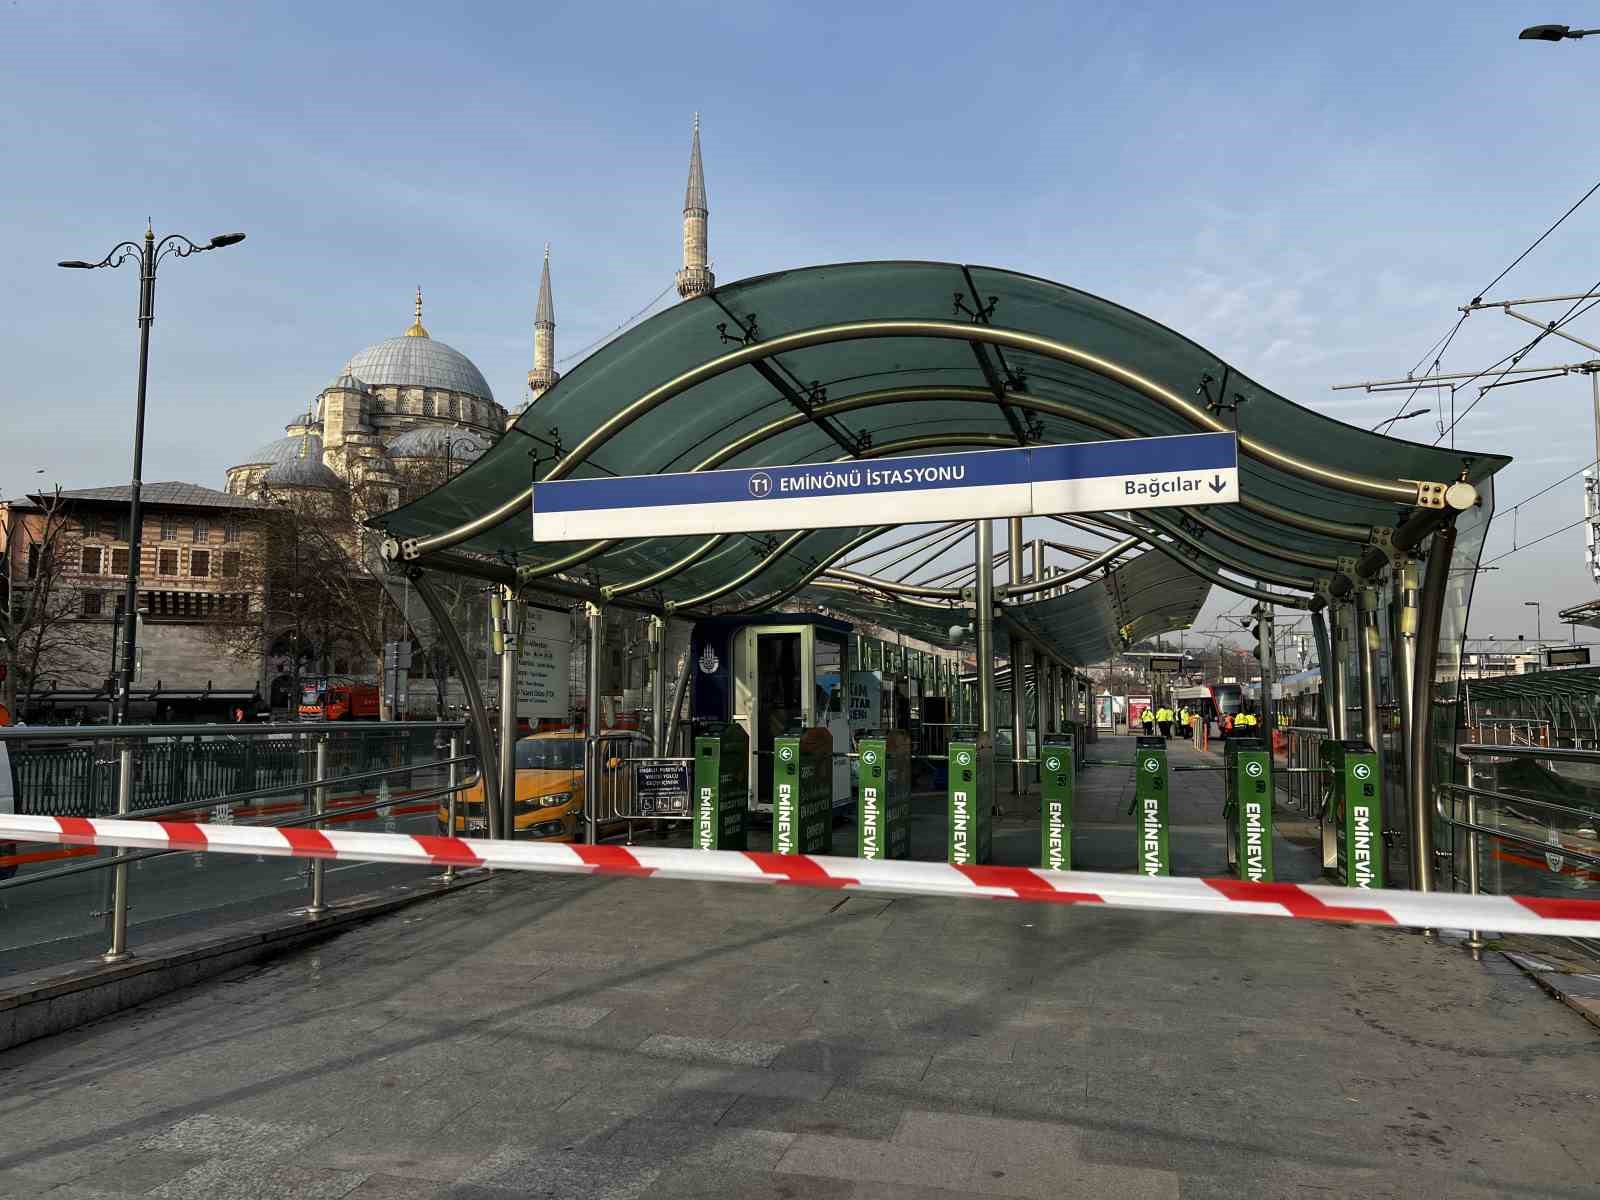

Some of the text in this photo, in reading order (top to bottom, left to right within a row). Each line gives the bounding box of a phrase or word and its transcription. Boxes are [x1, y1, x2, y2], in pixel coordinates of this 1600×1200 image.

[751, 465, 965, 493] T1 EMİNÖNÜ İSTASYONU
[1125, 476, 1202, 497] Bağcılar
